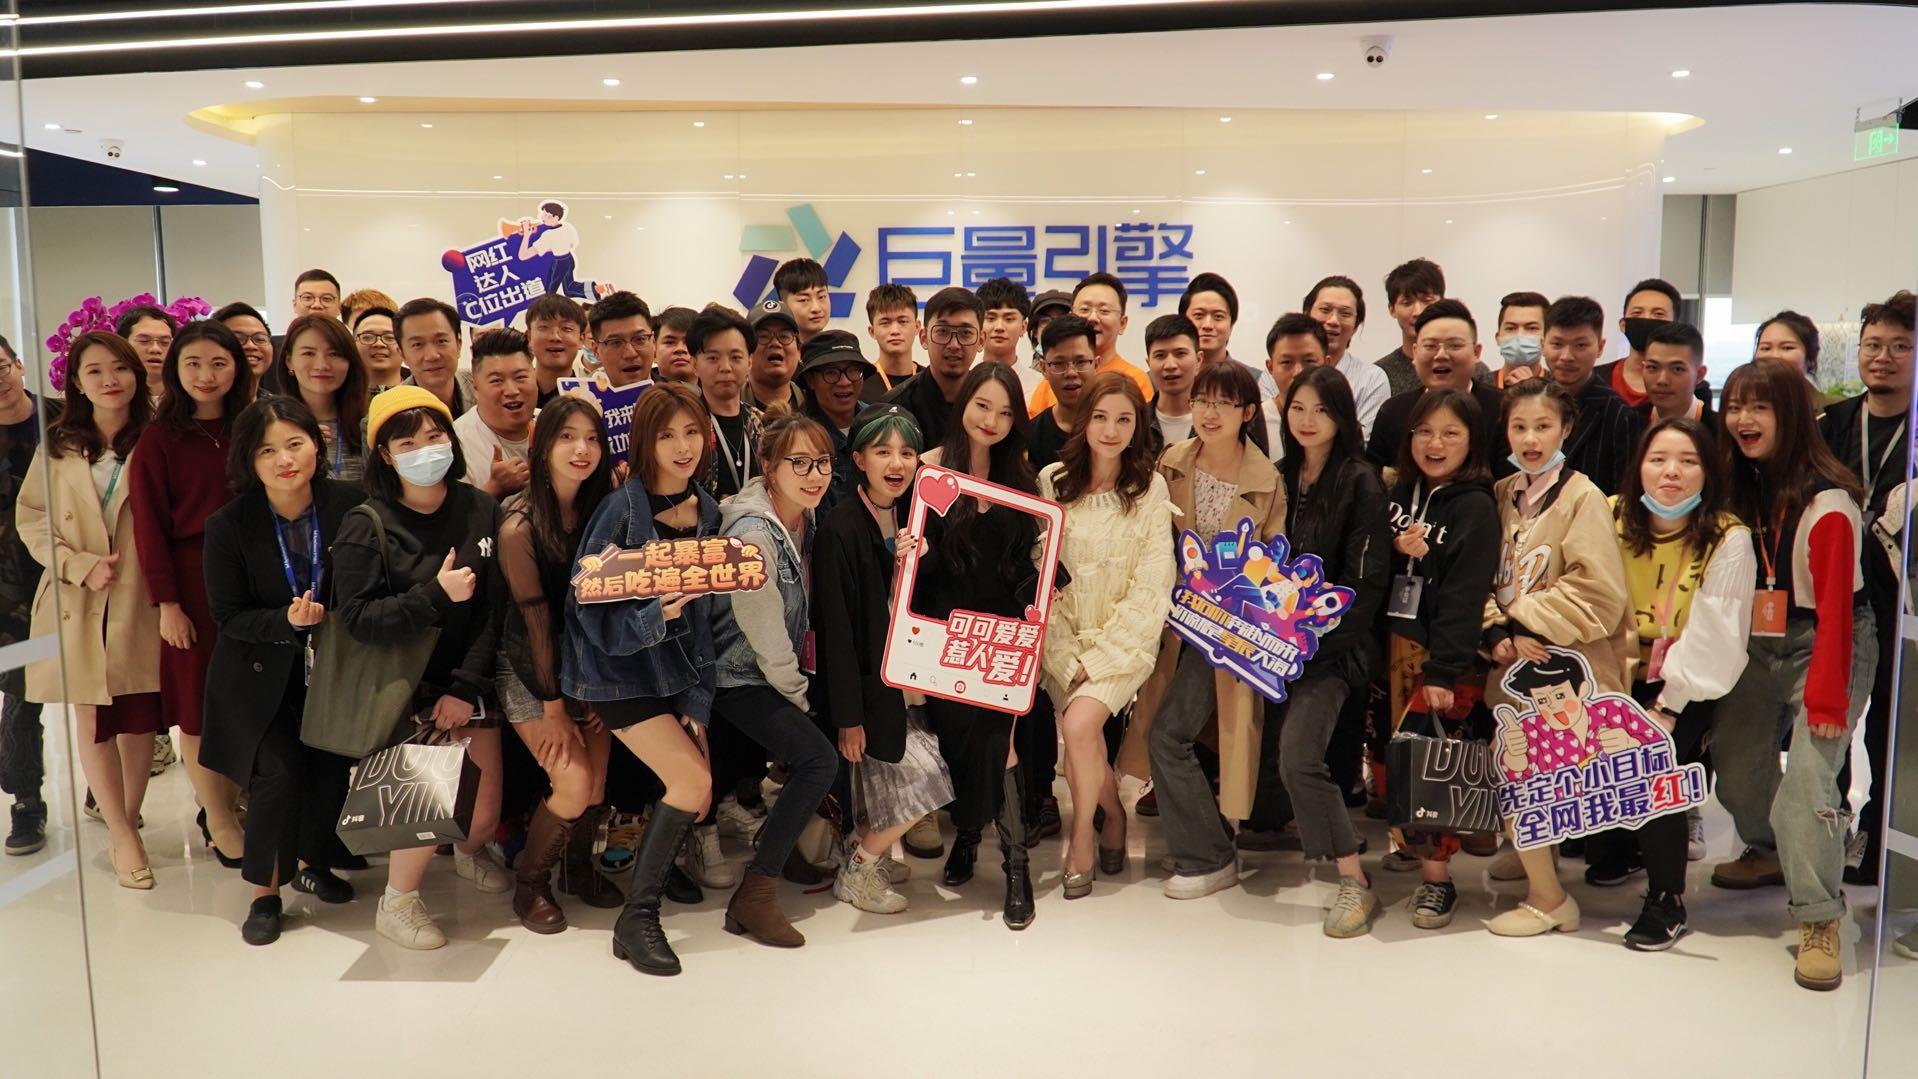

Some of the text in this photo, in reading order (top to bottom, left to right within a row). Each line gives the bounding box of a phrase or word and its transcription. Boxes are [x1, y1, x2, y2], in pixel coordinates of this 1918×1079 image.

[465, 242, 513, 273] 网红
[877, 221, 1195, 309] 巨量引擎
[473, 265, 520, 293] 达人
[465, 277, 546, 319] C位出道
[604, 402, 637, 428] 我来
[618, 538, 729, 568] 一起暴富
[580, 561, 766, 599] 然后吃遍全世界
[950, 612, 1041, 649] 可可爱爱
[1500, 742, 1670, 813] 先定个小目标
